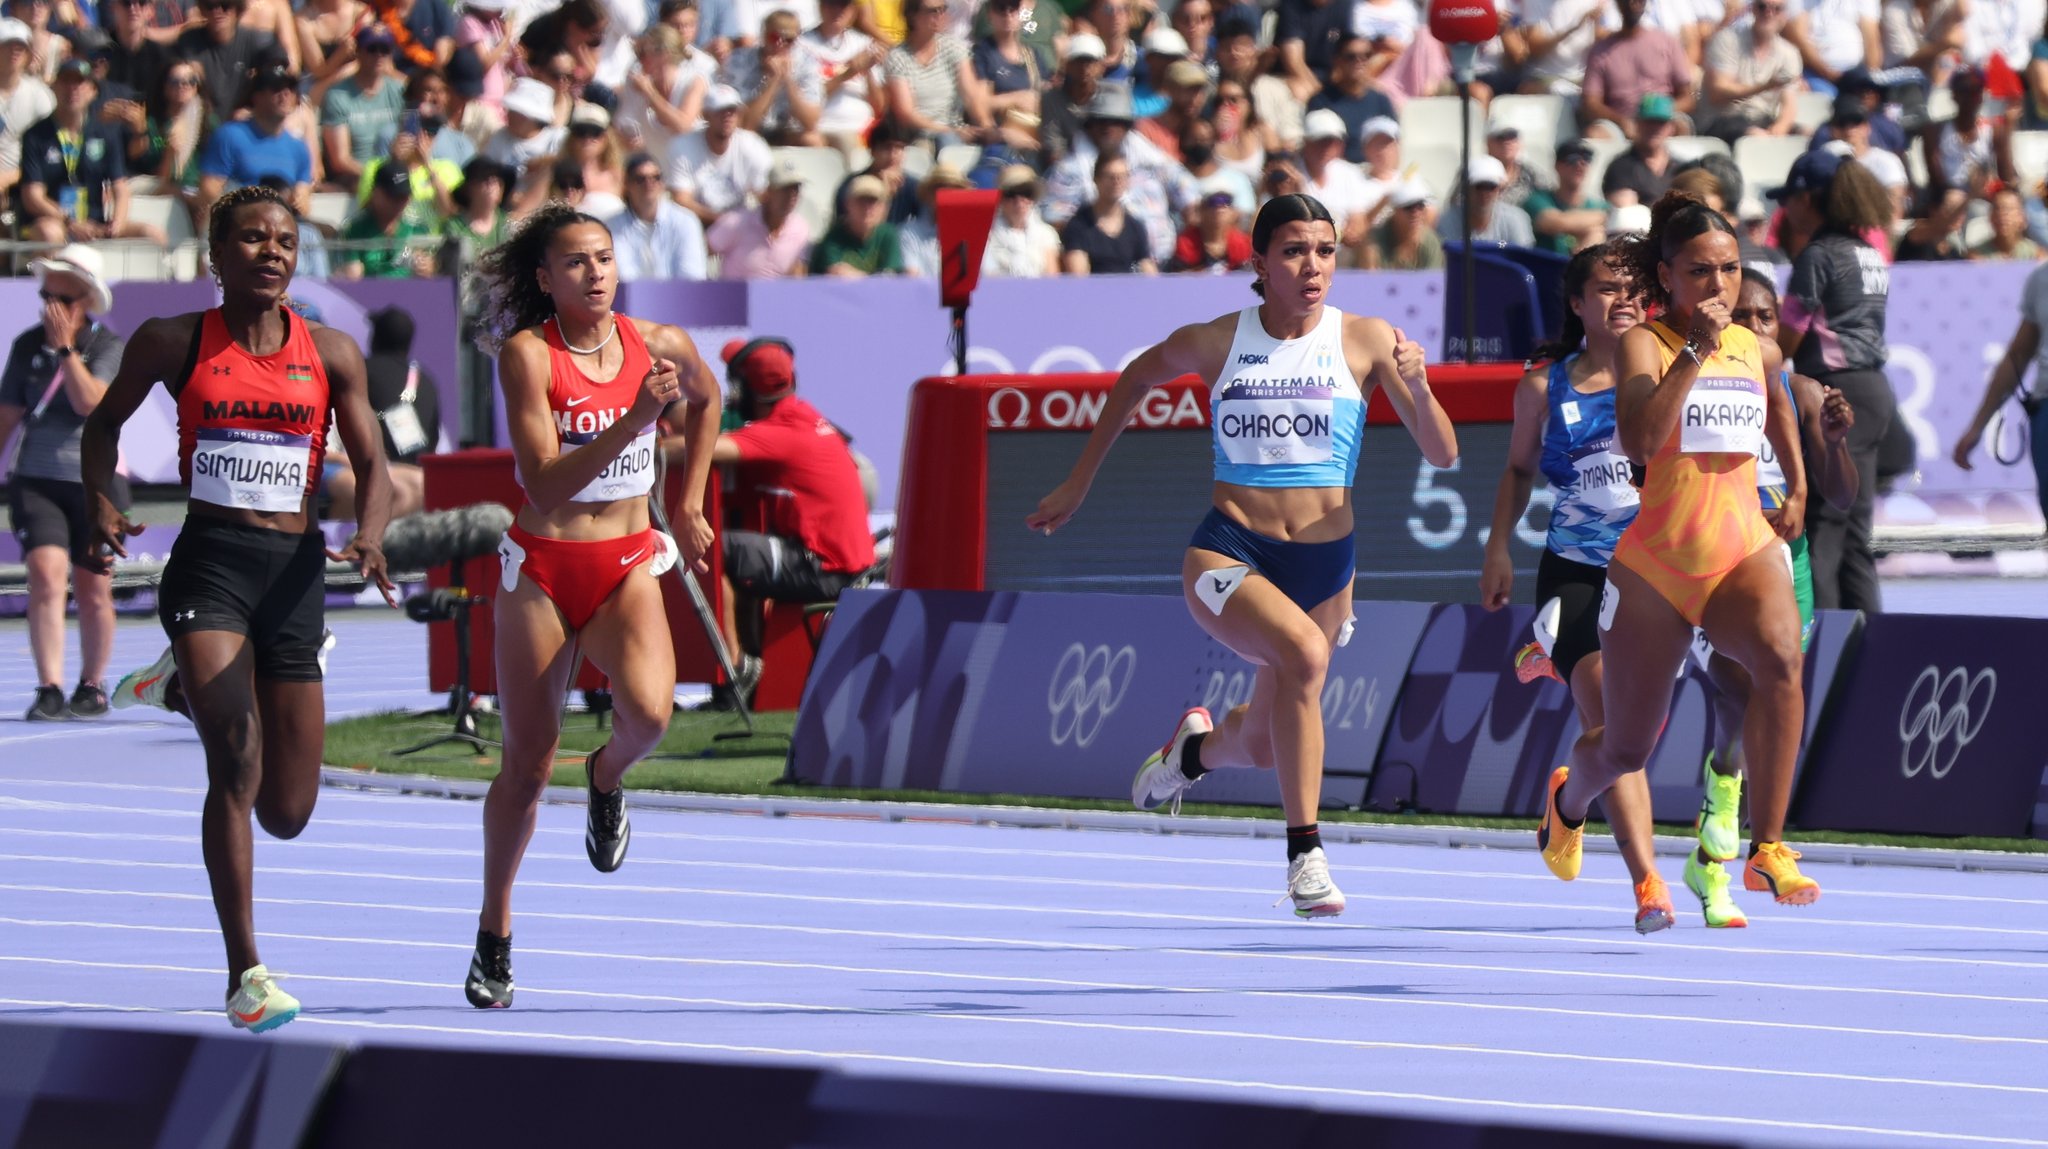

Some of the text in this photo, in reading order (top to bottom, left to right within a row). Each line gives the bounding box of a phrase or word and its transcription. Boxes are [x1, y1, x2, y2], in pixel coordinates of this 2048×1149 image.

[1238, 353, 1269, 365] HOKA
[1231, 375, 1336, 388] GUATEMALA
[1245, 388, 1303, 396] PARIS 2024
[1707, 380, 1732, 388] PARIS
[203, 400, 316, 425] MALAWI
[1041, 387, 1205, 428] OMGA
[1687, 404, 1764, 430] AKAKPO
[227, 430, 257, 440] PARIS
[1222, 413, 1329, 438] CHACON
[196, 452, 301, 486] SIMWAKA
[1582, 460, 1631, 491] MANA
